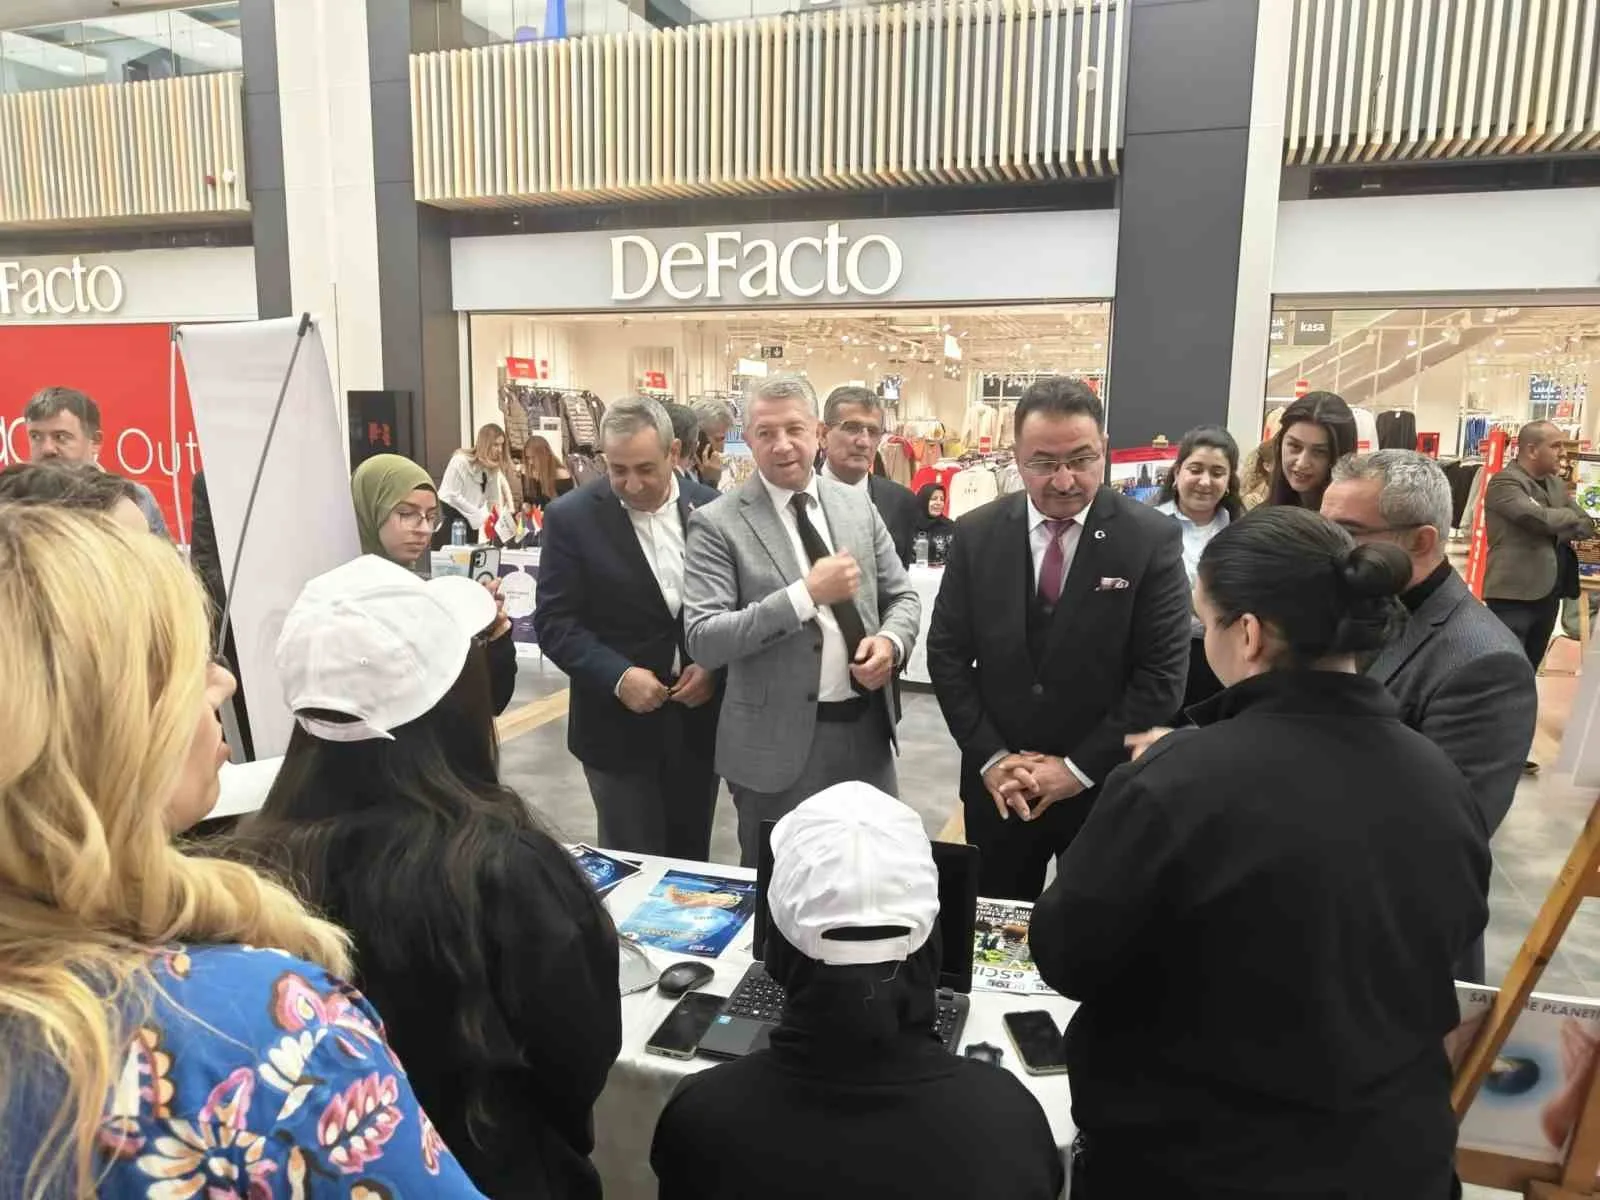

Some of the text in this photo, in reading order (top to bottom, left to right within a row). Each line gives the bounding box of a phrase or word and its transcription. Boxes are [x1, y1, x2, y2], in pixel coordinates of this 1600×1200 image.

[0, 256, 122, 314] Facto
[609, 222, 903, 301] DeFacto
[1300, 321, 1325, 332] kasa
